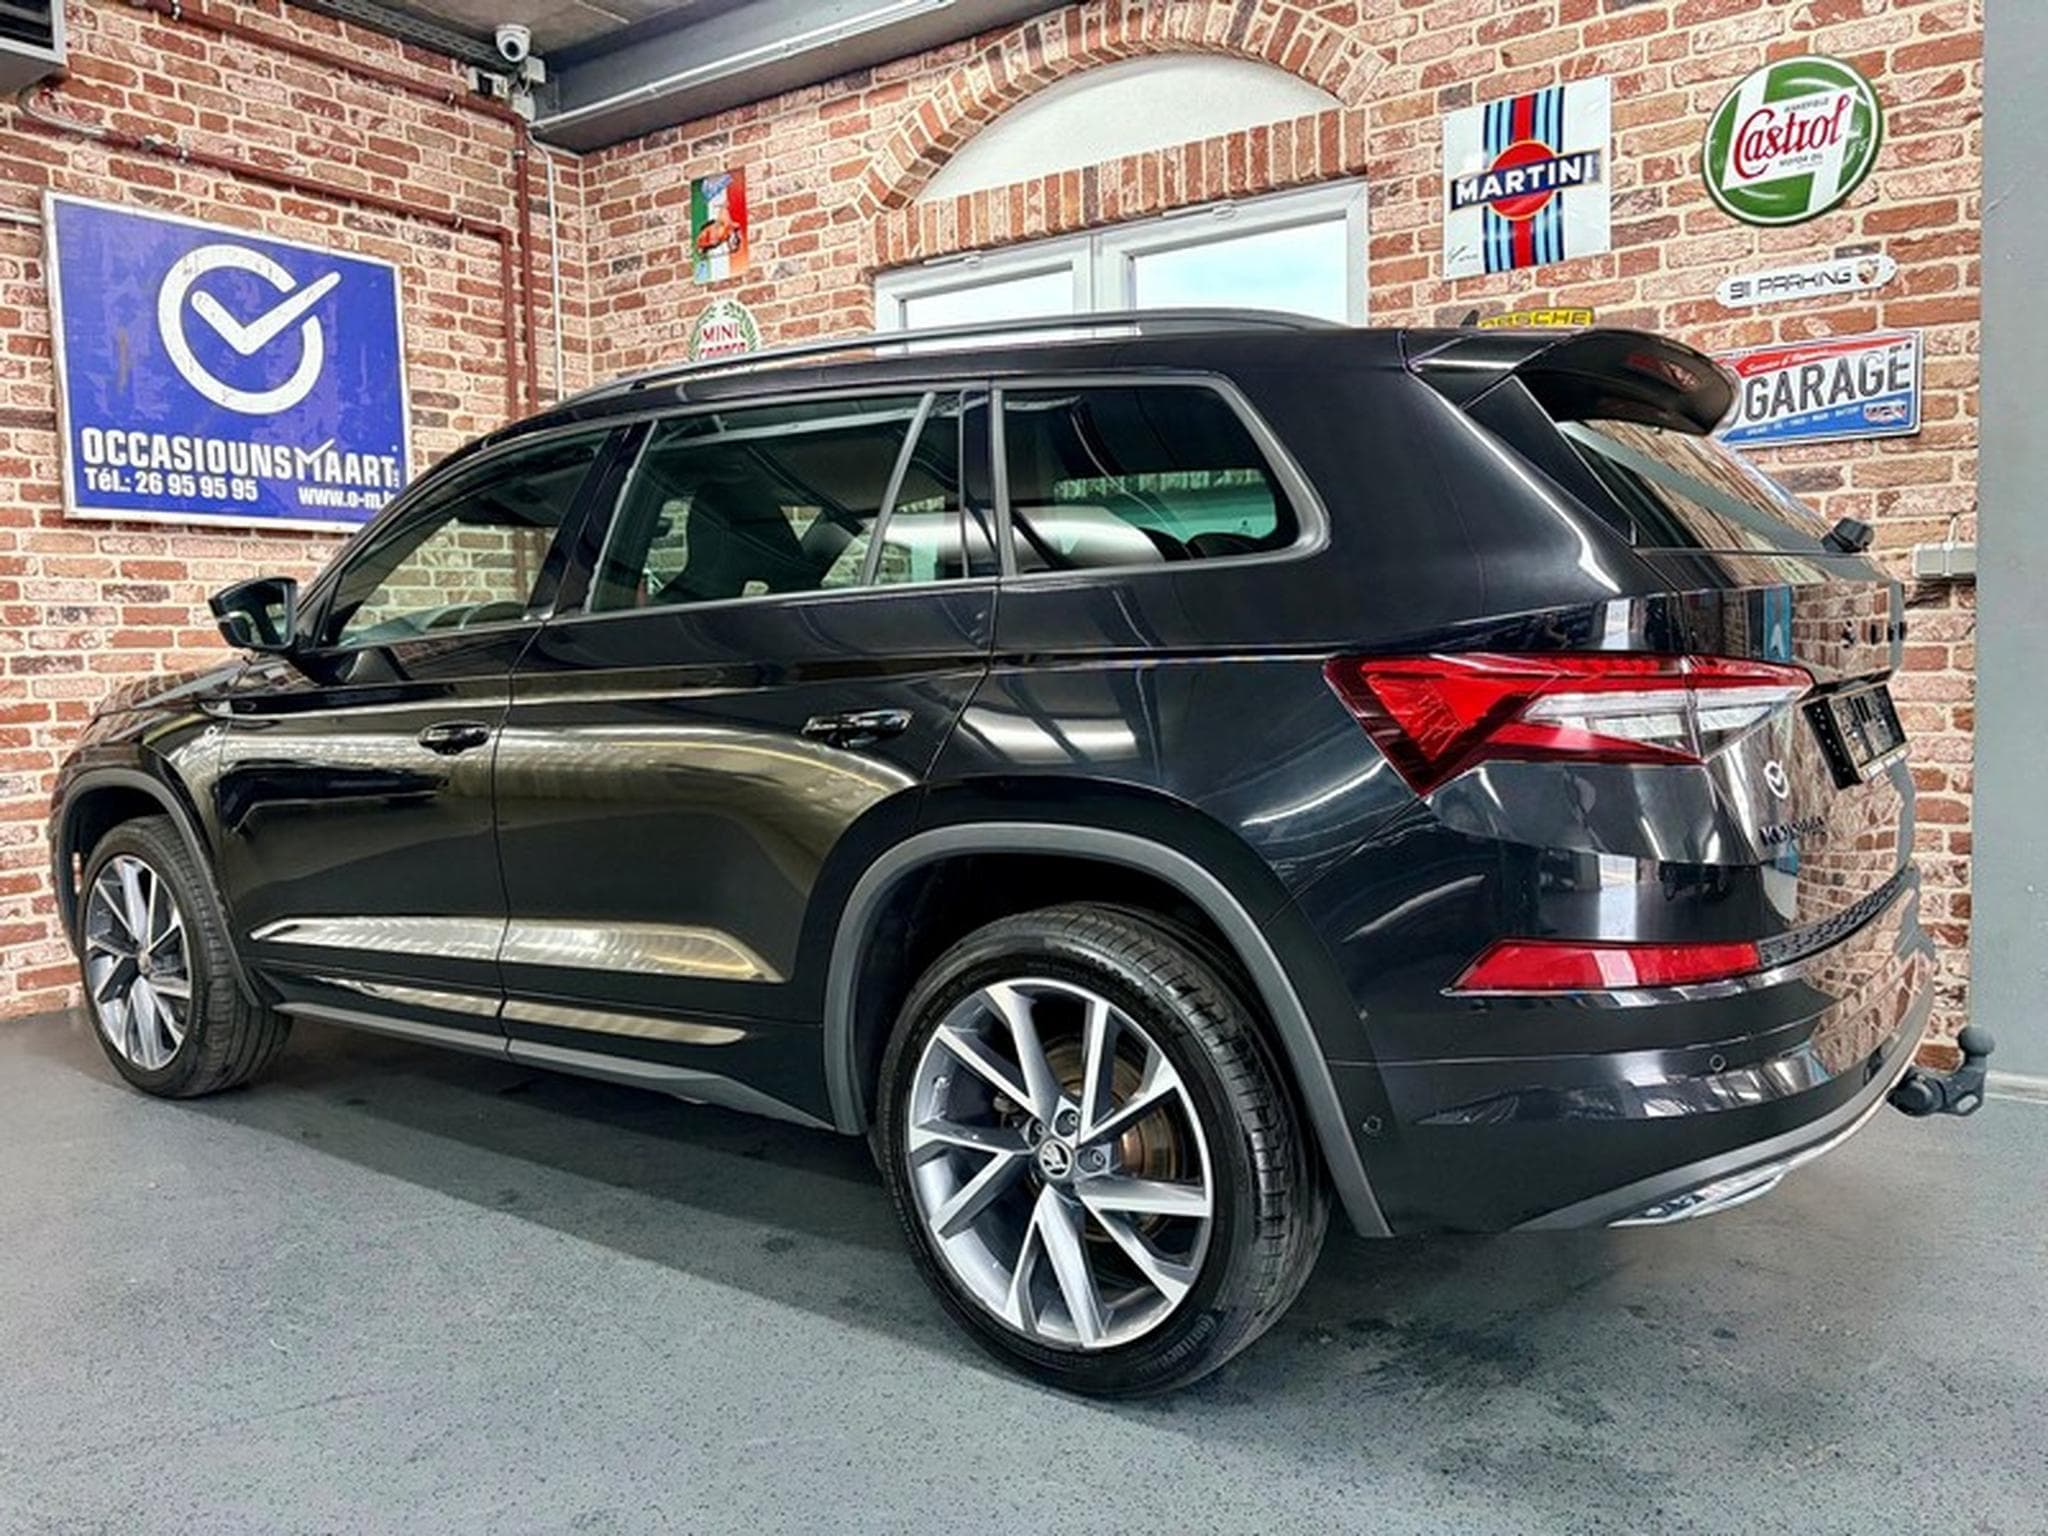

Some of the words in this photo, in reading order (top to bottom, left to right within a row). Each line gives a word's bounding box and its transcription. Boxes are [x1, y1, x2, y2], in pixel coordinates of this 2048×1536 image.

[1733, 94, 1852, 179] Castrol
[1455, 156, 1595, 206] MARTINI
[1757, 268, 1852, 293] PARKING
[702, 322, 738, 342] MINI
[1743, 342, 1911, 423] GARAGE
[135, 470, 163, 495] 26
[167, 473, 196, 497] 95
[200, 475, 227, 499] 95
[230, 477, 258, 501] 95
